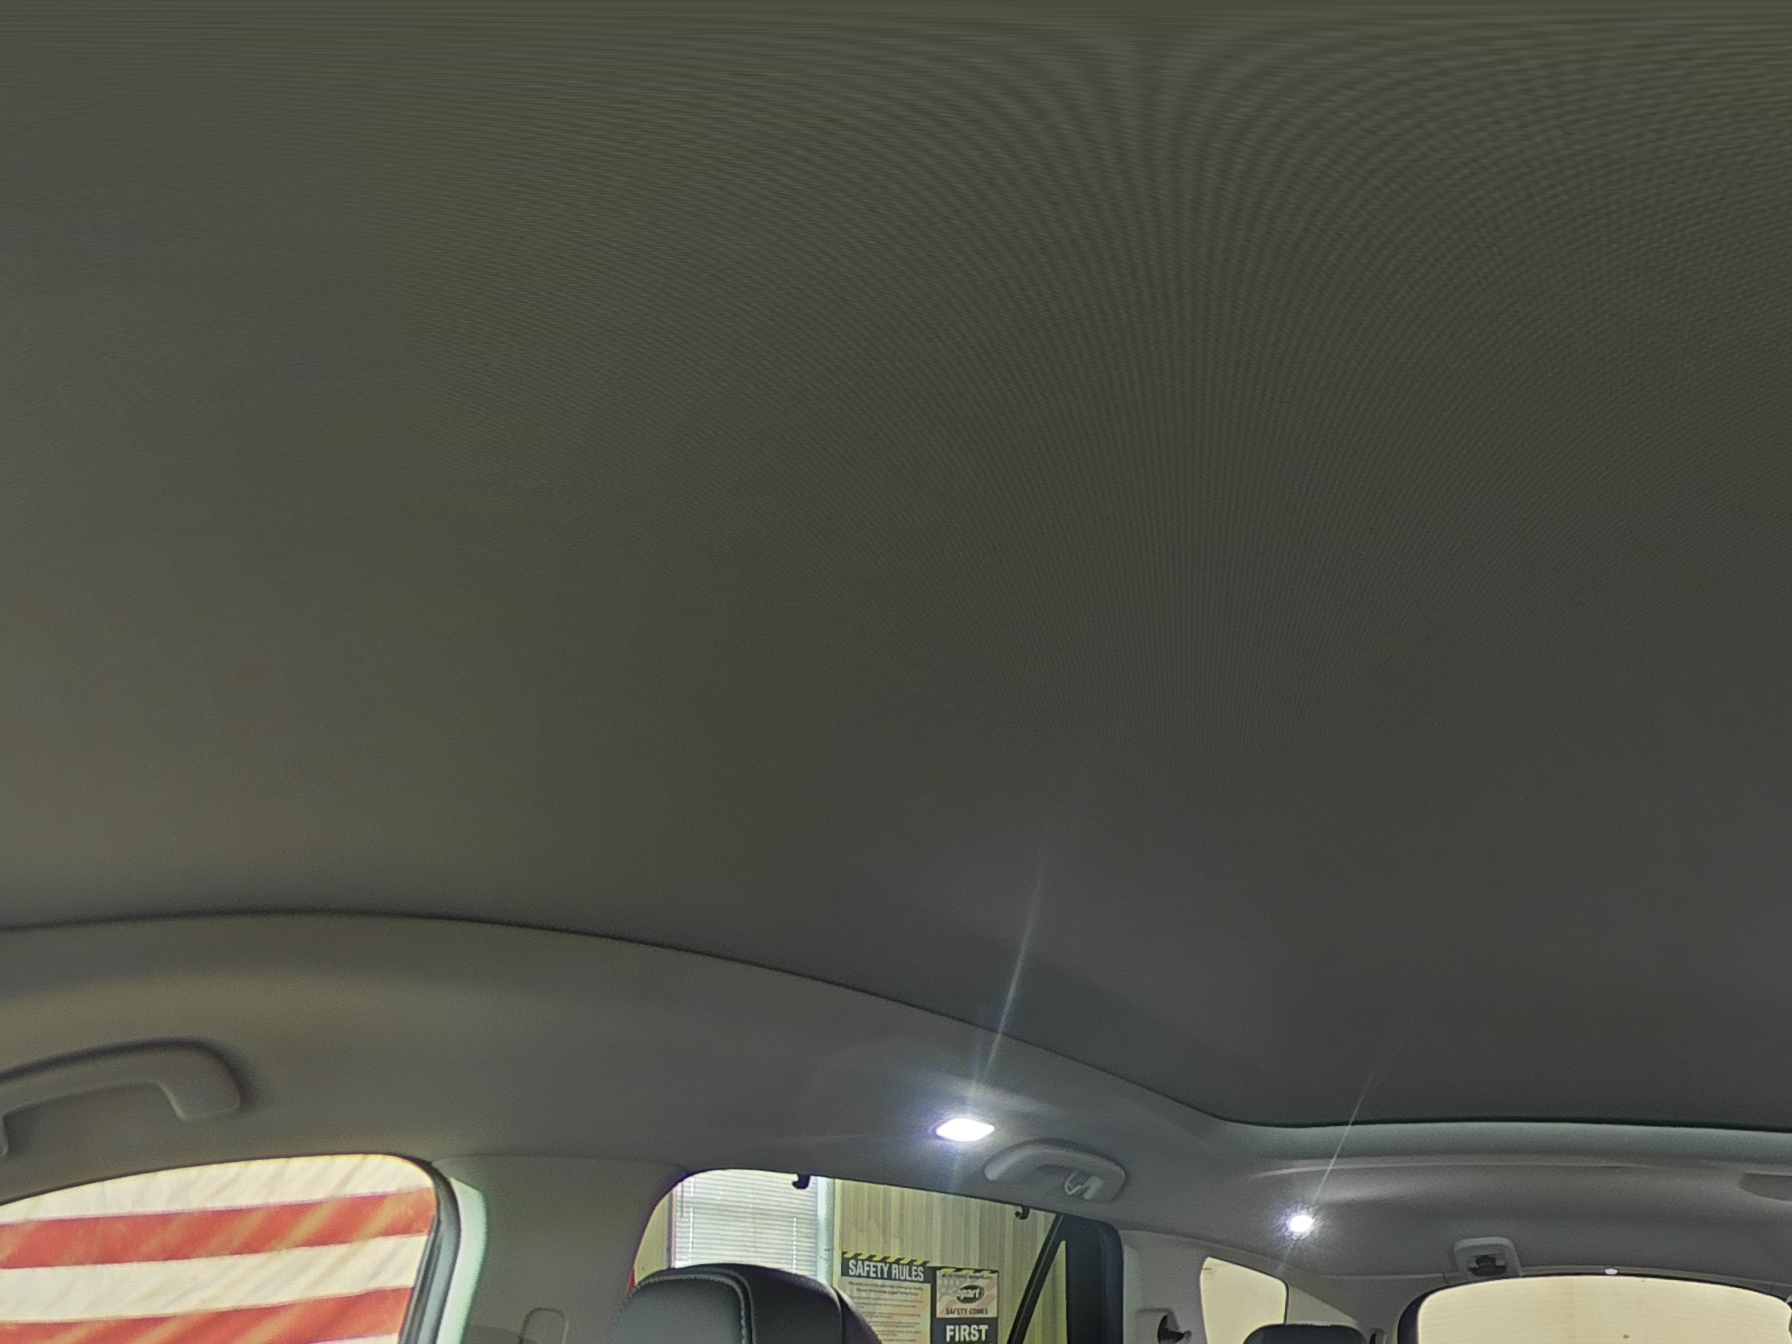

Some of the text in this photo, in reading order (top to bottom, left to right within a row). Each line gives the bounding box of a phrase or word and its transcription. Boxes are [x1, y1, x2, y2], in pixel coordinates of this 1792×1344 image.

[848, 1259, 925, 1282] SAFETY RULES
[946, 1324, 990, 1343] FIRST
